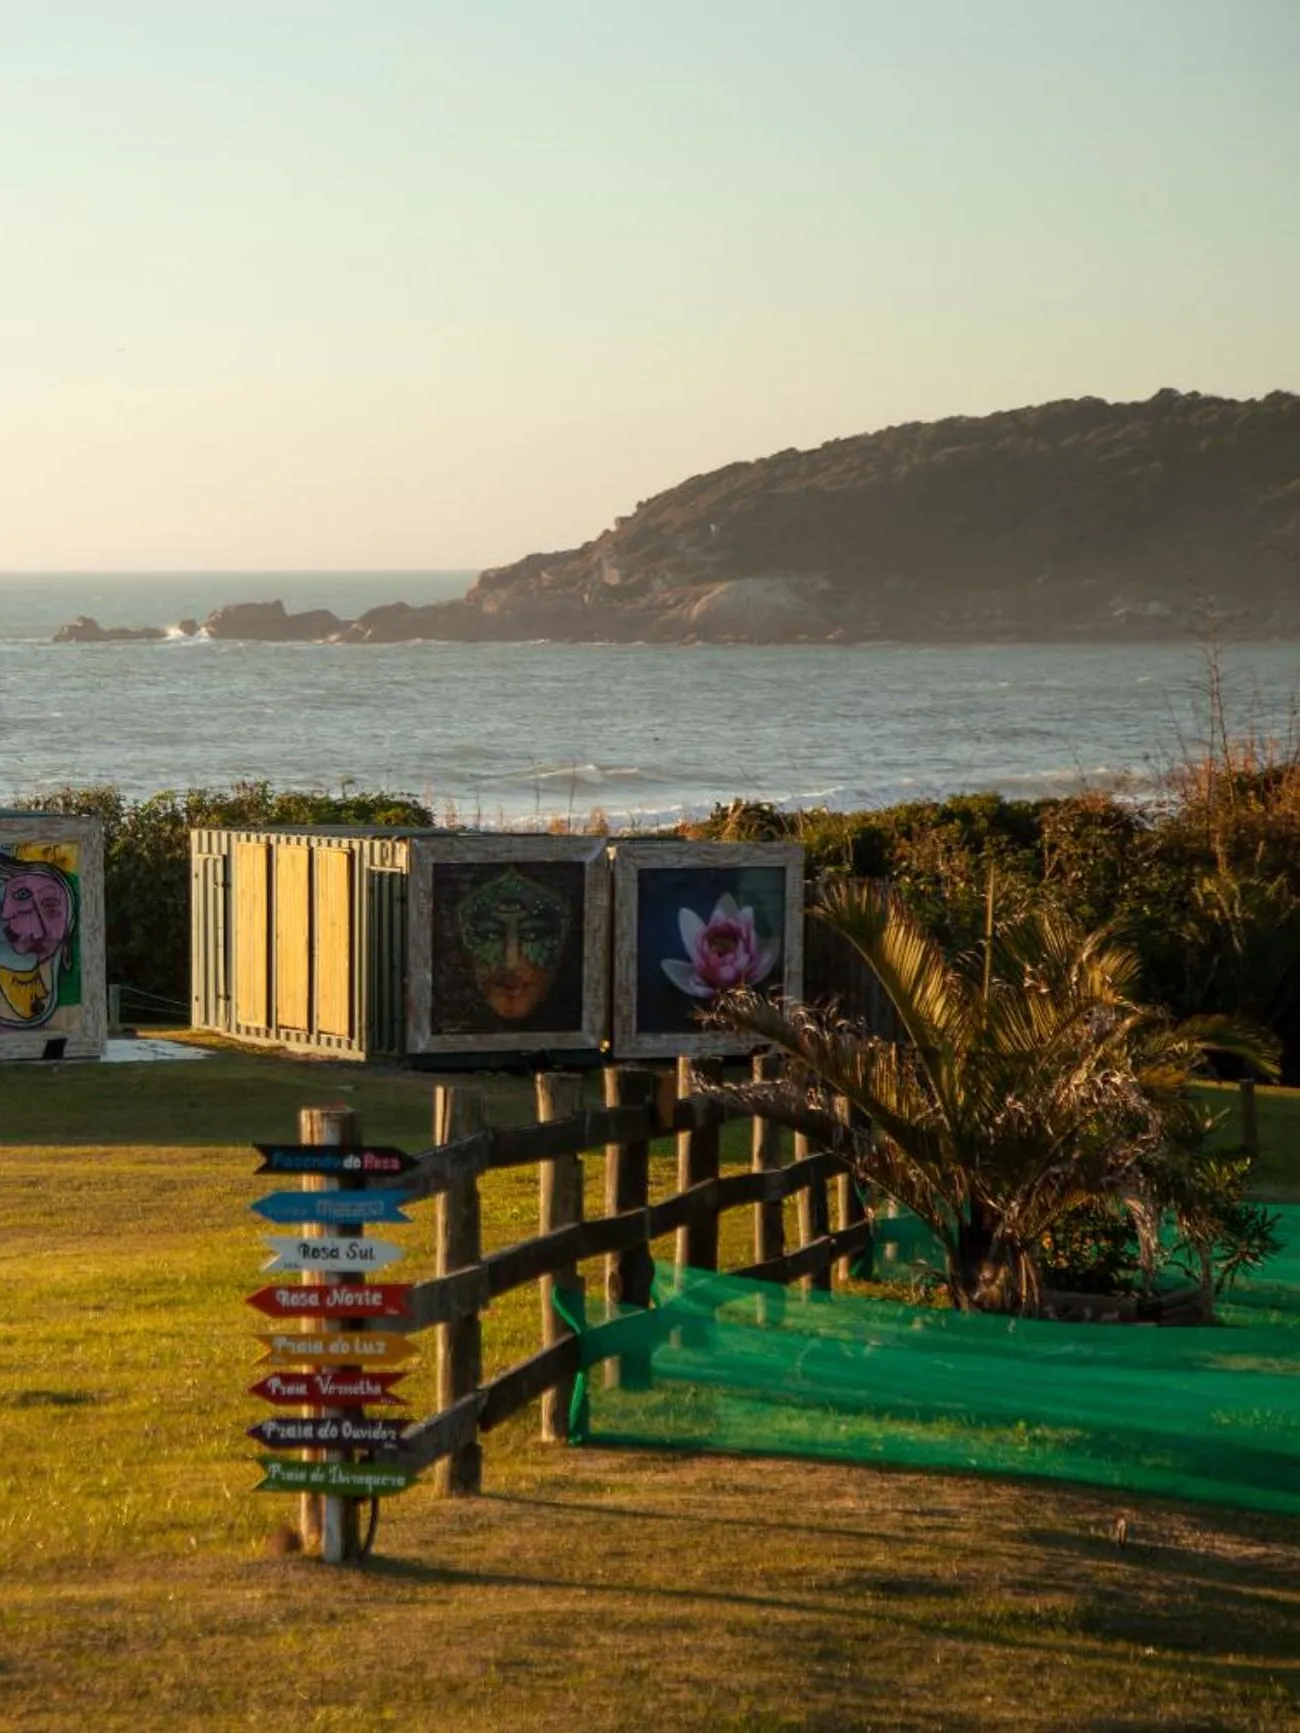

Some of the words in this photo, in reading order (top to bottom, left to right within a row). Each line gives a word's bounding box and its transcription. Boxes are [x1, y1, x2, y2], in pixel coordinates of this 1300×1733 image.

[297, 1243, 339, 1260] Rosa
[346, 1242, 375, 1260] Sul
[276, 1290, 320, 1307] Rosa
[326, 1288, 382, 1307] Norte
[273, 1335, 324, 1354] Praia
[268, 1376, 308, 1396] Praia
[261, 1420, 313, 1439] Praia
[317, 1421, 338, 1439] do
[341, 1421, 396, 1440] Ouvidor
[268, 1463, 306, 1481] Praia
